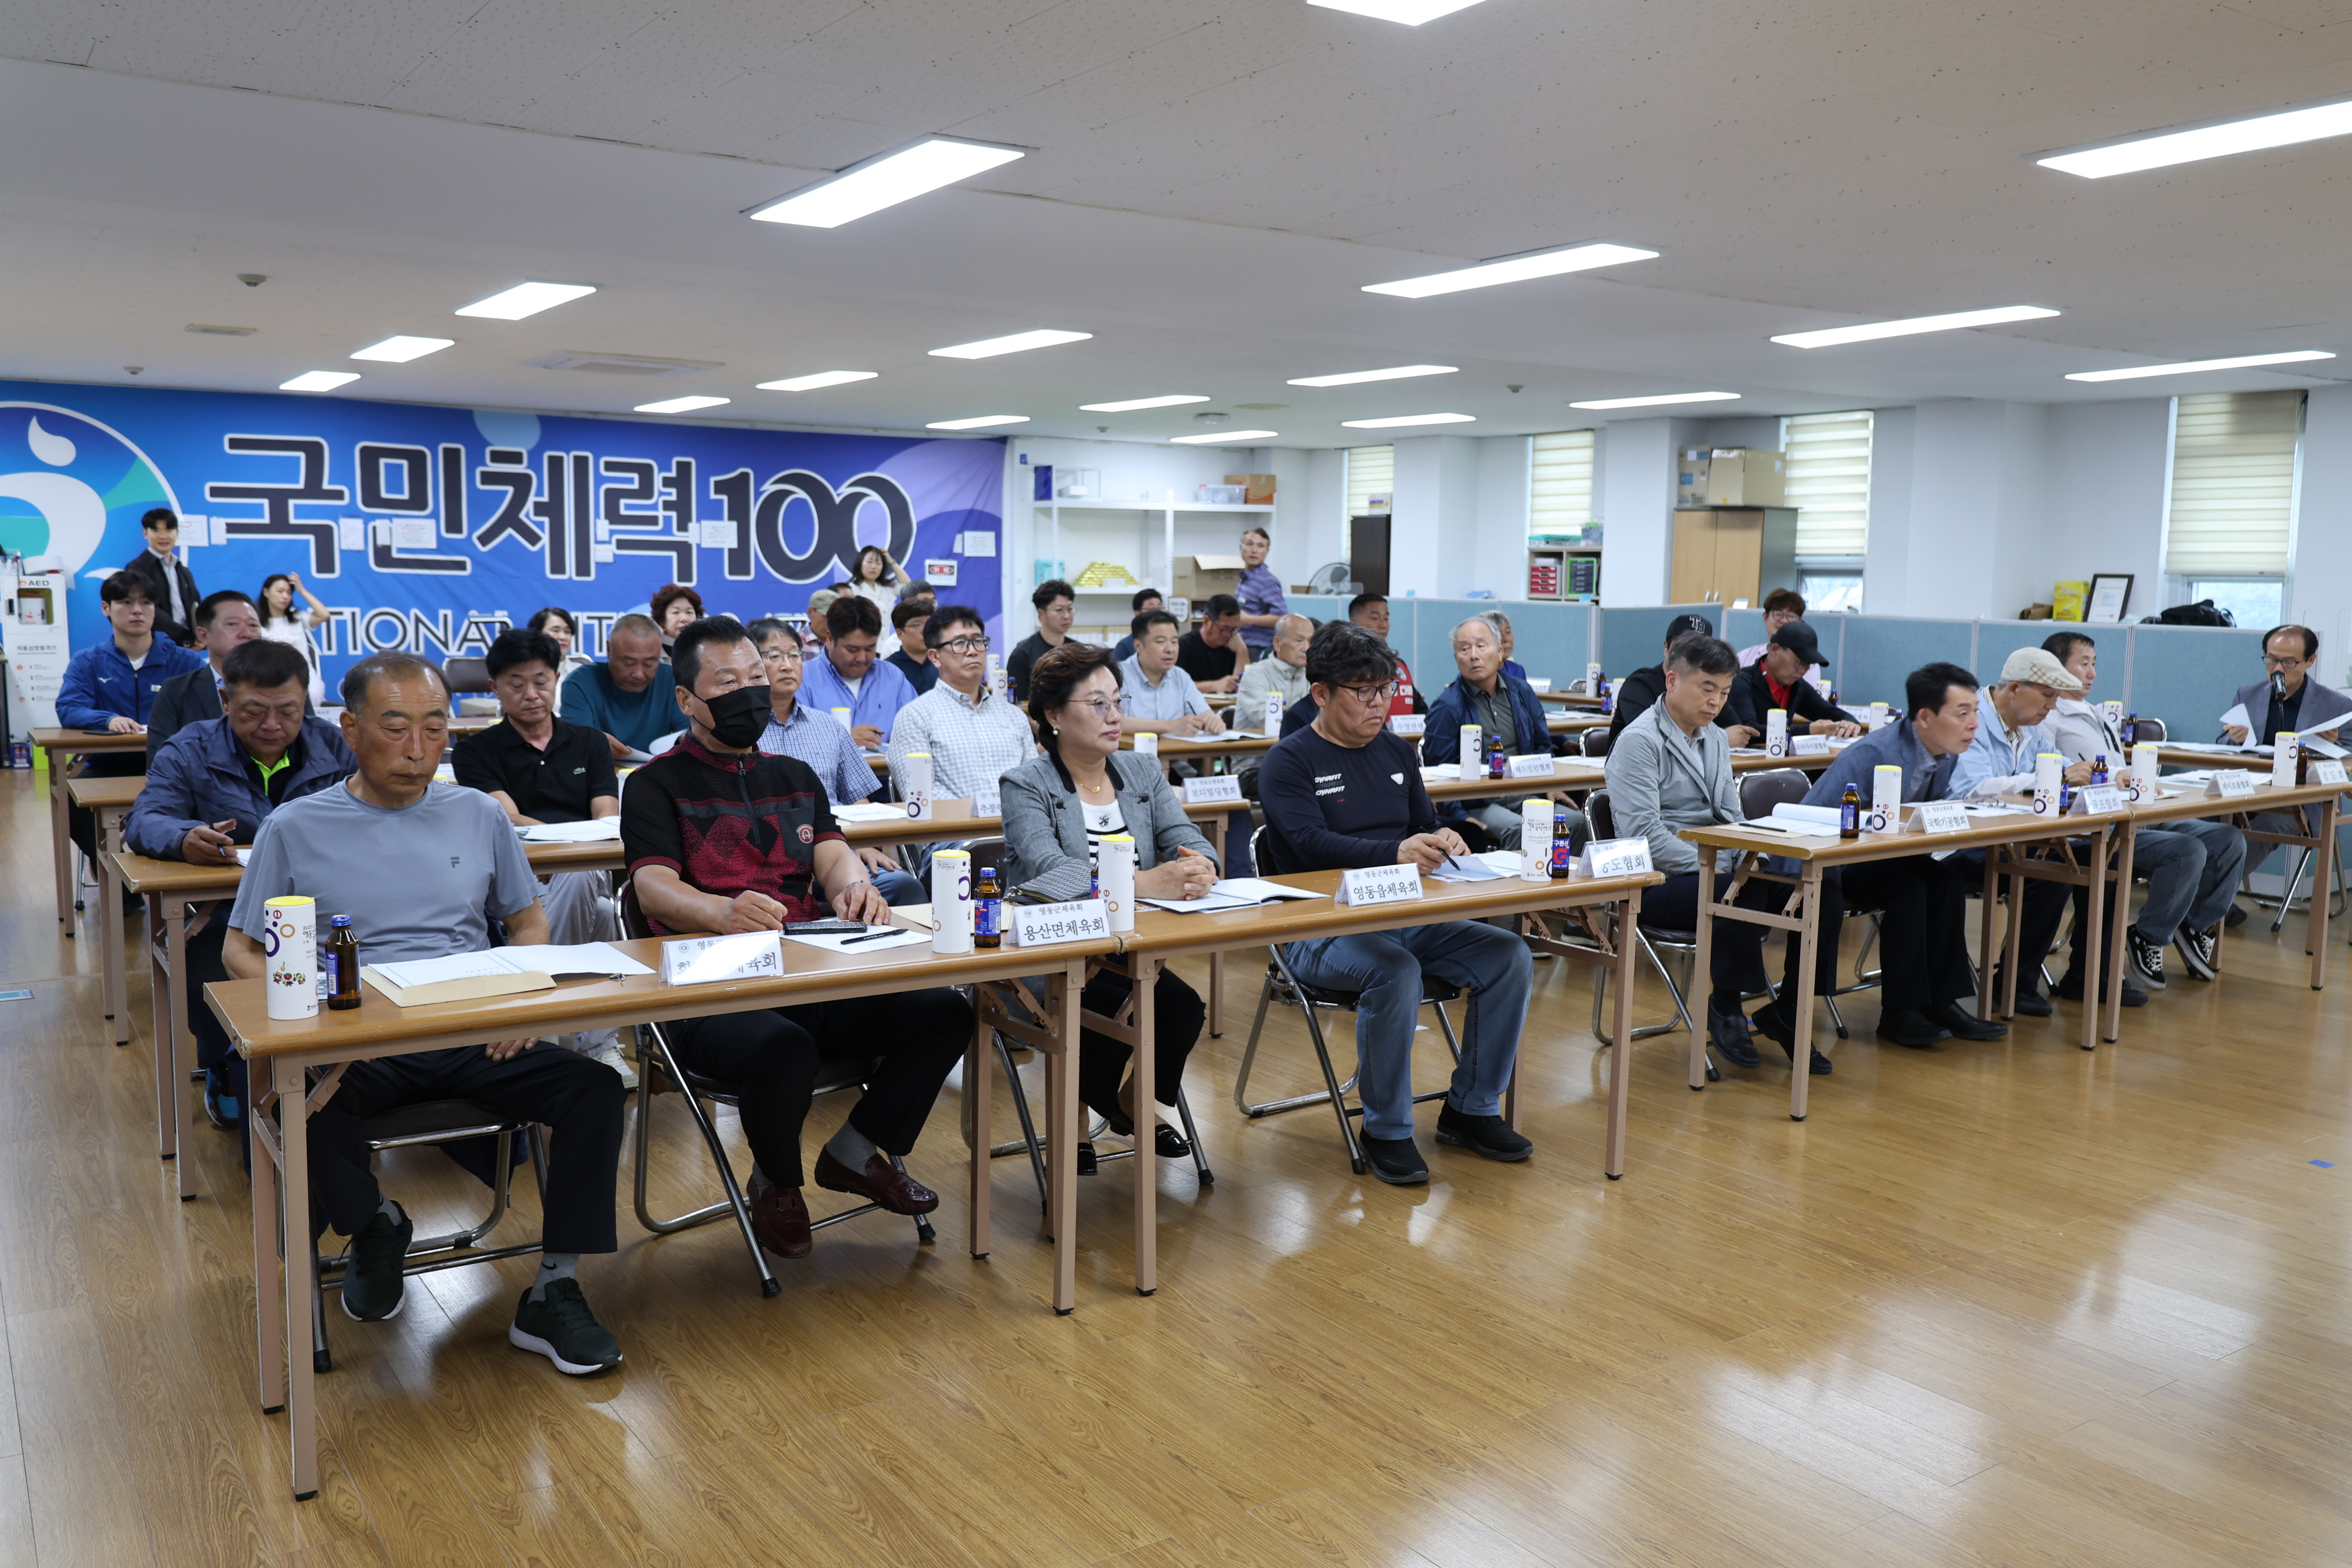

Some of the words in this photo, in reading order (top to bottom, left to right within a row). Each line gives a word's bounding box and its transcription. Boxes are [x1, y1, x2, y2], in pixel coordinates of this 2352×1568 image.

[205, 433, 917, 586] 국민체력100
[1314, 773, 1342, 784] DYNAFIT
[1315, 785, 1345, 797] DYNAFIT
[1364, 867, 1401, 878] 영동군체육회
[1353, 880, 1419, 901] 영동읍체육회
[1038, 903, 1083, 916] 영동군체육회
[1023, 916, 1105, 942] 용산면체육회
